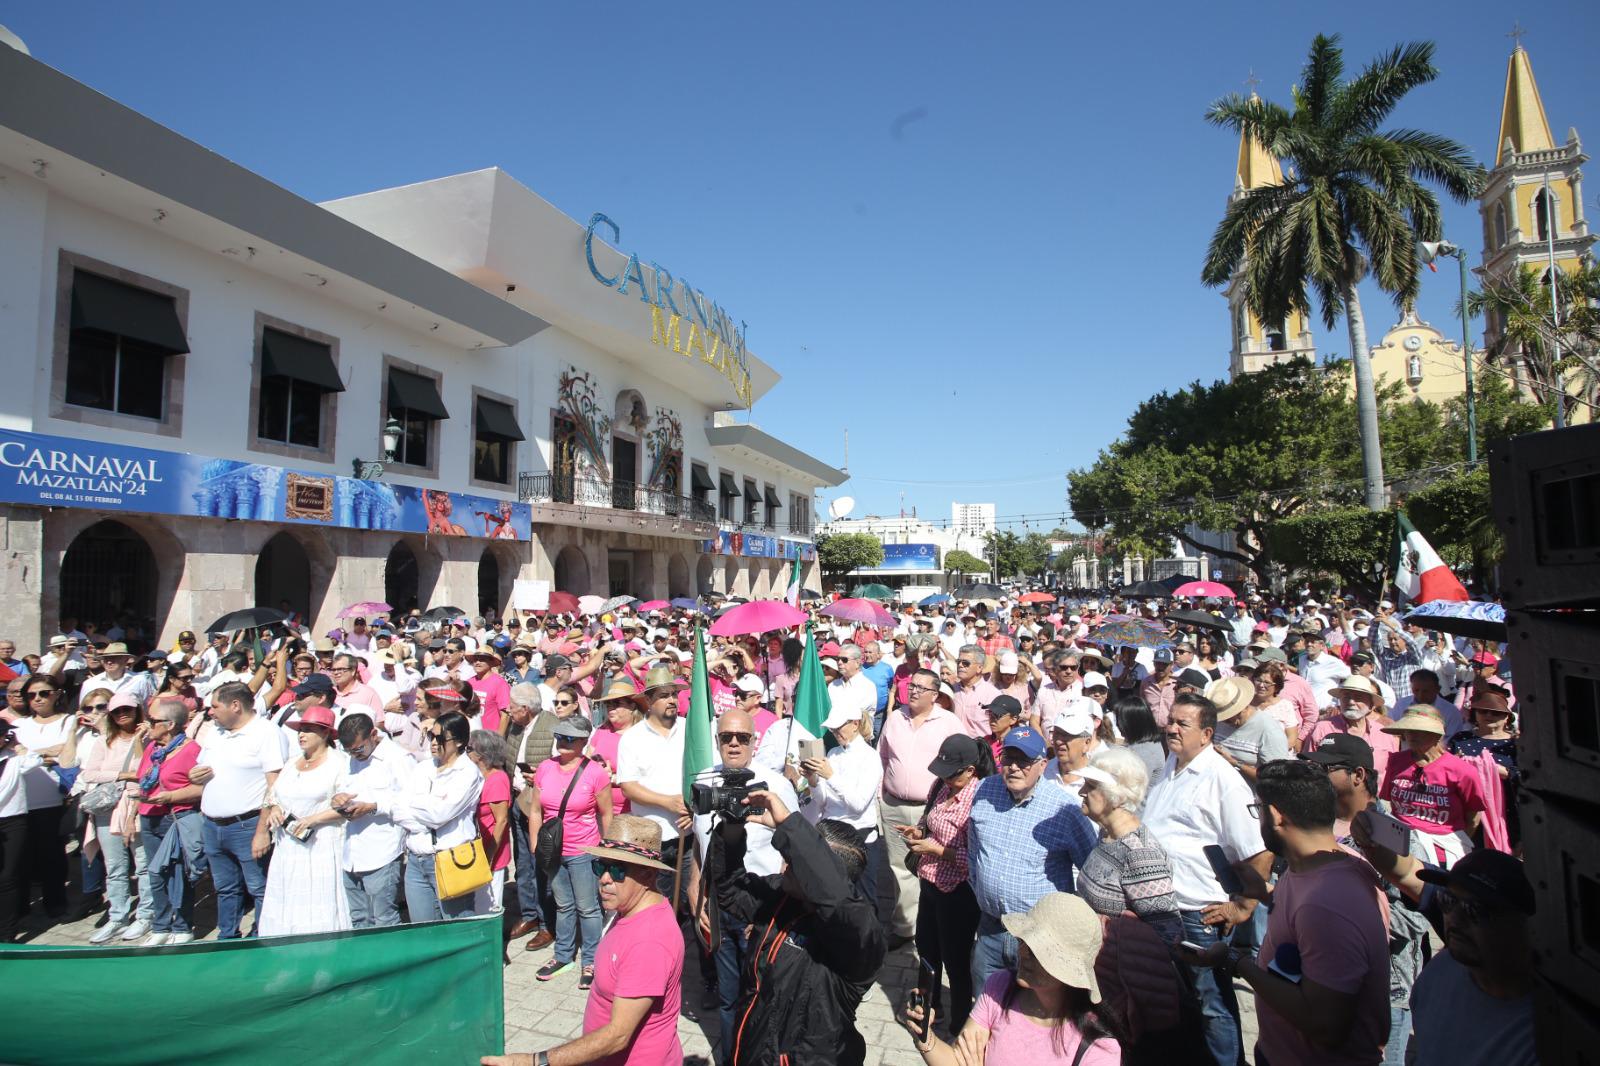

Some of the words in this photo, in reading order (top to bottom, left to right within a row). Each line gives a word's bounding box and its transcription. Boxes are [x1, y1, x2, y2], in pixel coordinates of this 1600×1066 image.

[0, 441, 163, 482] CARNAVAL
[65, 493, 74, 501] AL
[94, 496, 122, 505] FEBRERO
[1398, 789, 1434, 805] FUTURO
[1437, 796, 1450, 808] DE
